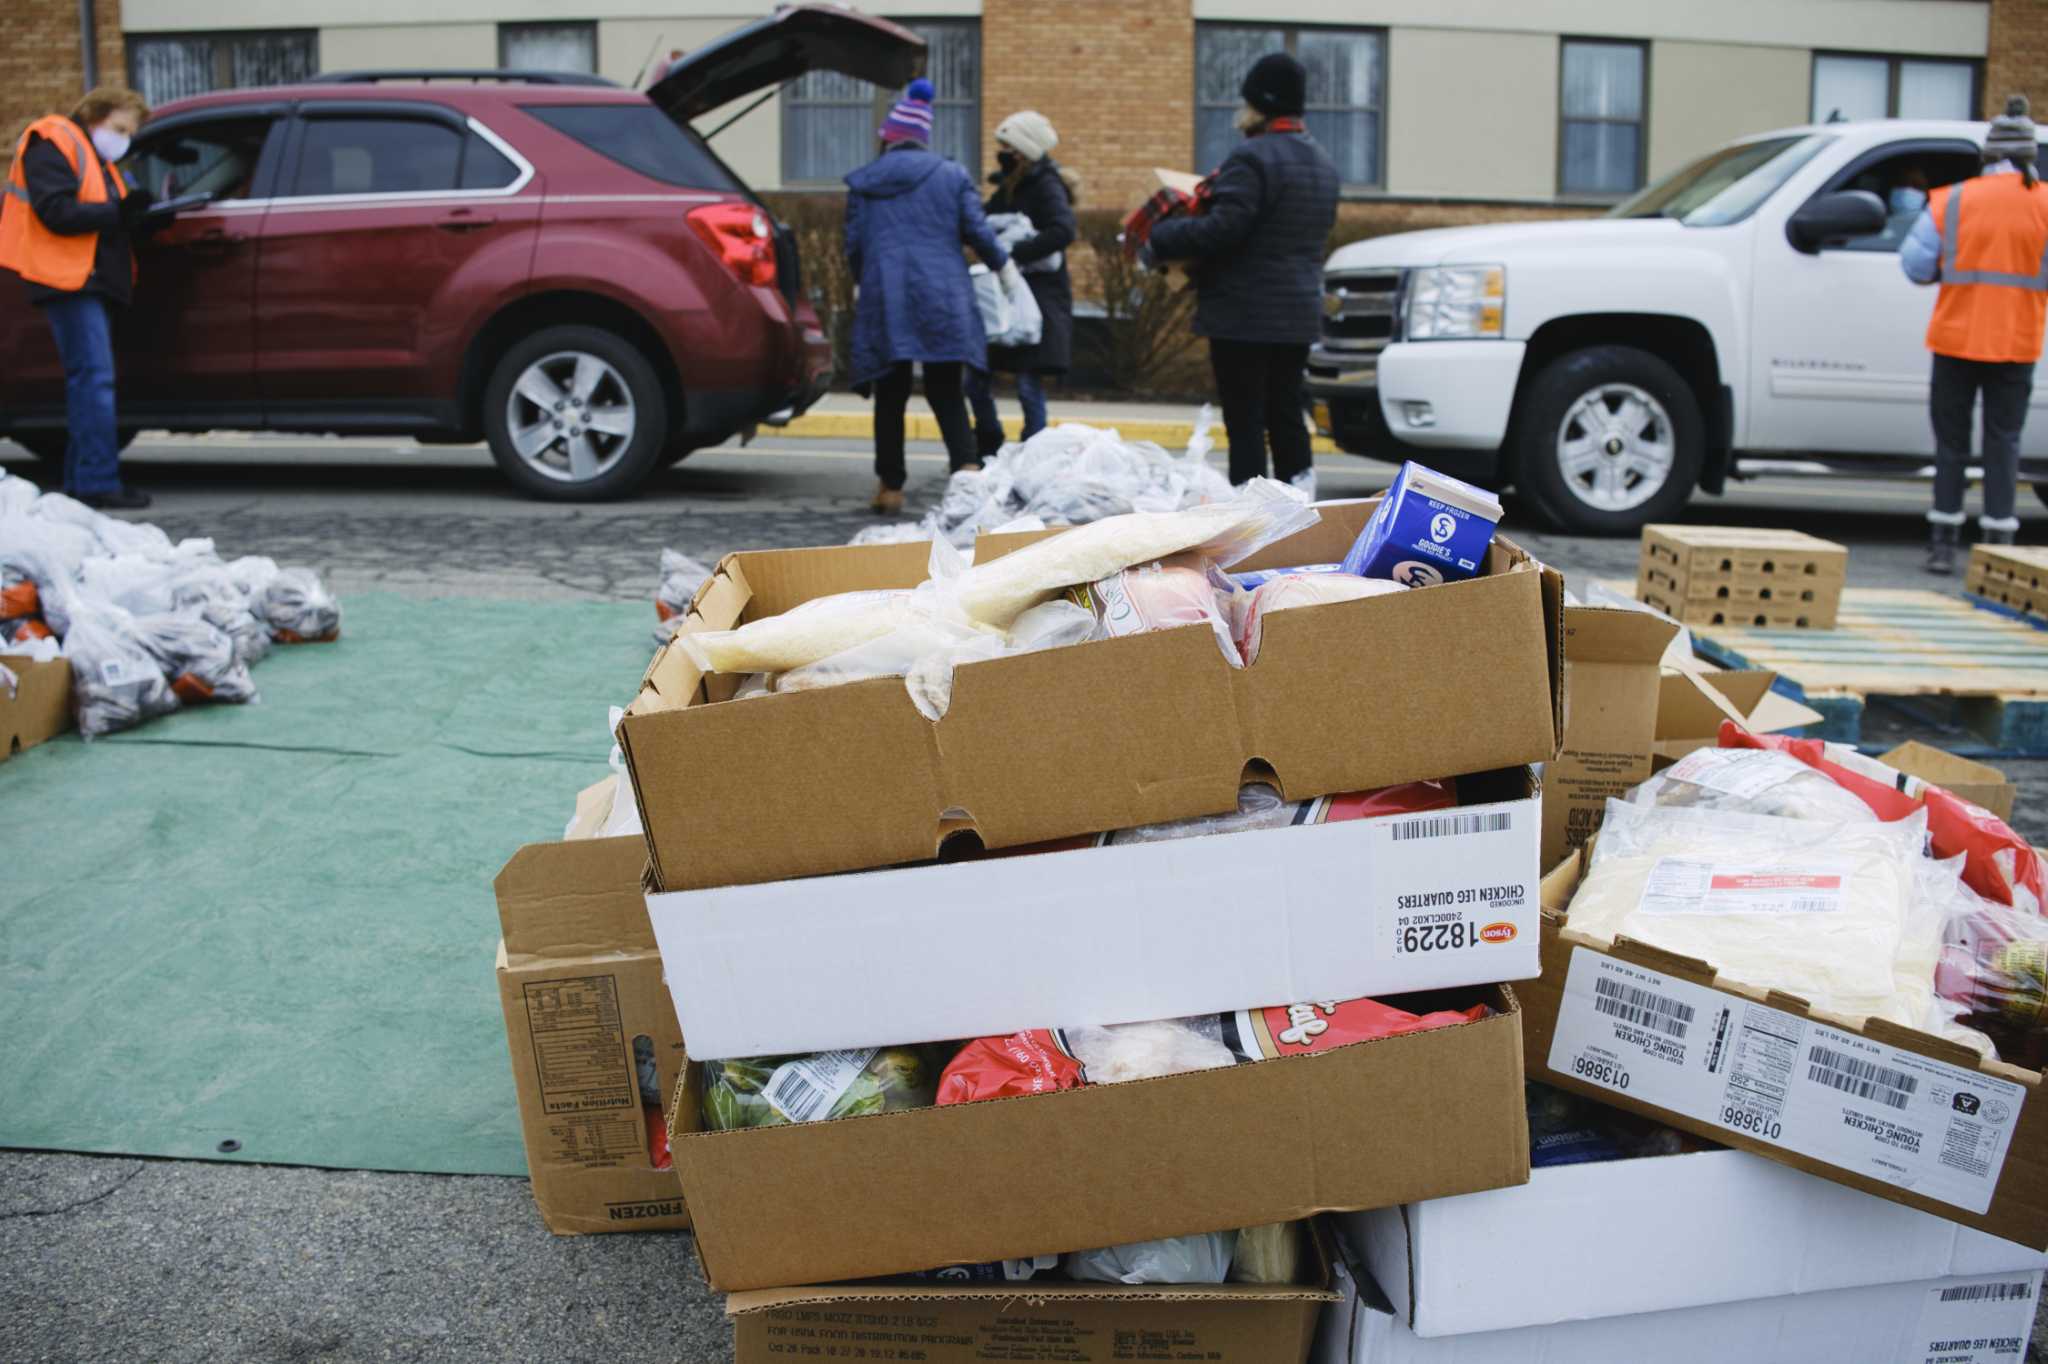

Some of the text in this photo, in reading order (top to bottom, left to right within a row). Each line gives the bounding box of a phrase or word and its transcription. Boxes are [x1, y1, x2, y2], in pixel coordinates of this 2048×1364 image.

[1429, 500, 1470, 520] KEEP FROZEN
[1398, 884, 1524, 909] CHICKEN LEG QUARTERS
[1489, 898, 1525, 908] UNCOOKED
[1404, 921, 1479, 953] 18229
[1615, 1029, 1685, 1060] YOUNG CHICKEN
[1576, 1057, 1630, 1089] 013686
[1724, 1106, 1782, 1140] 013686
[1844, 1116, 1921, 1148] YOUNG CHICKEN
[610, 1202, 683, 1220] FROZEN
[1929, 1337, 2023, 1352] CHICKEN LEG QUARTERS
